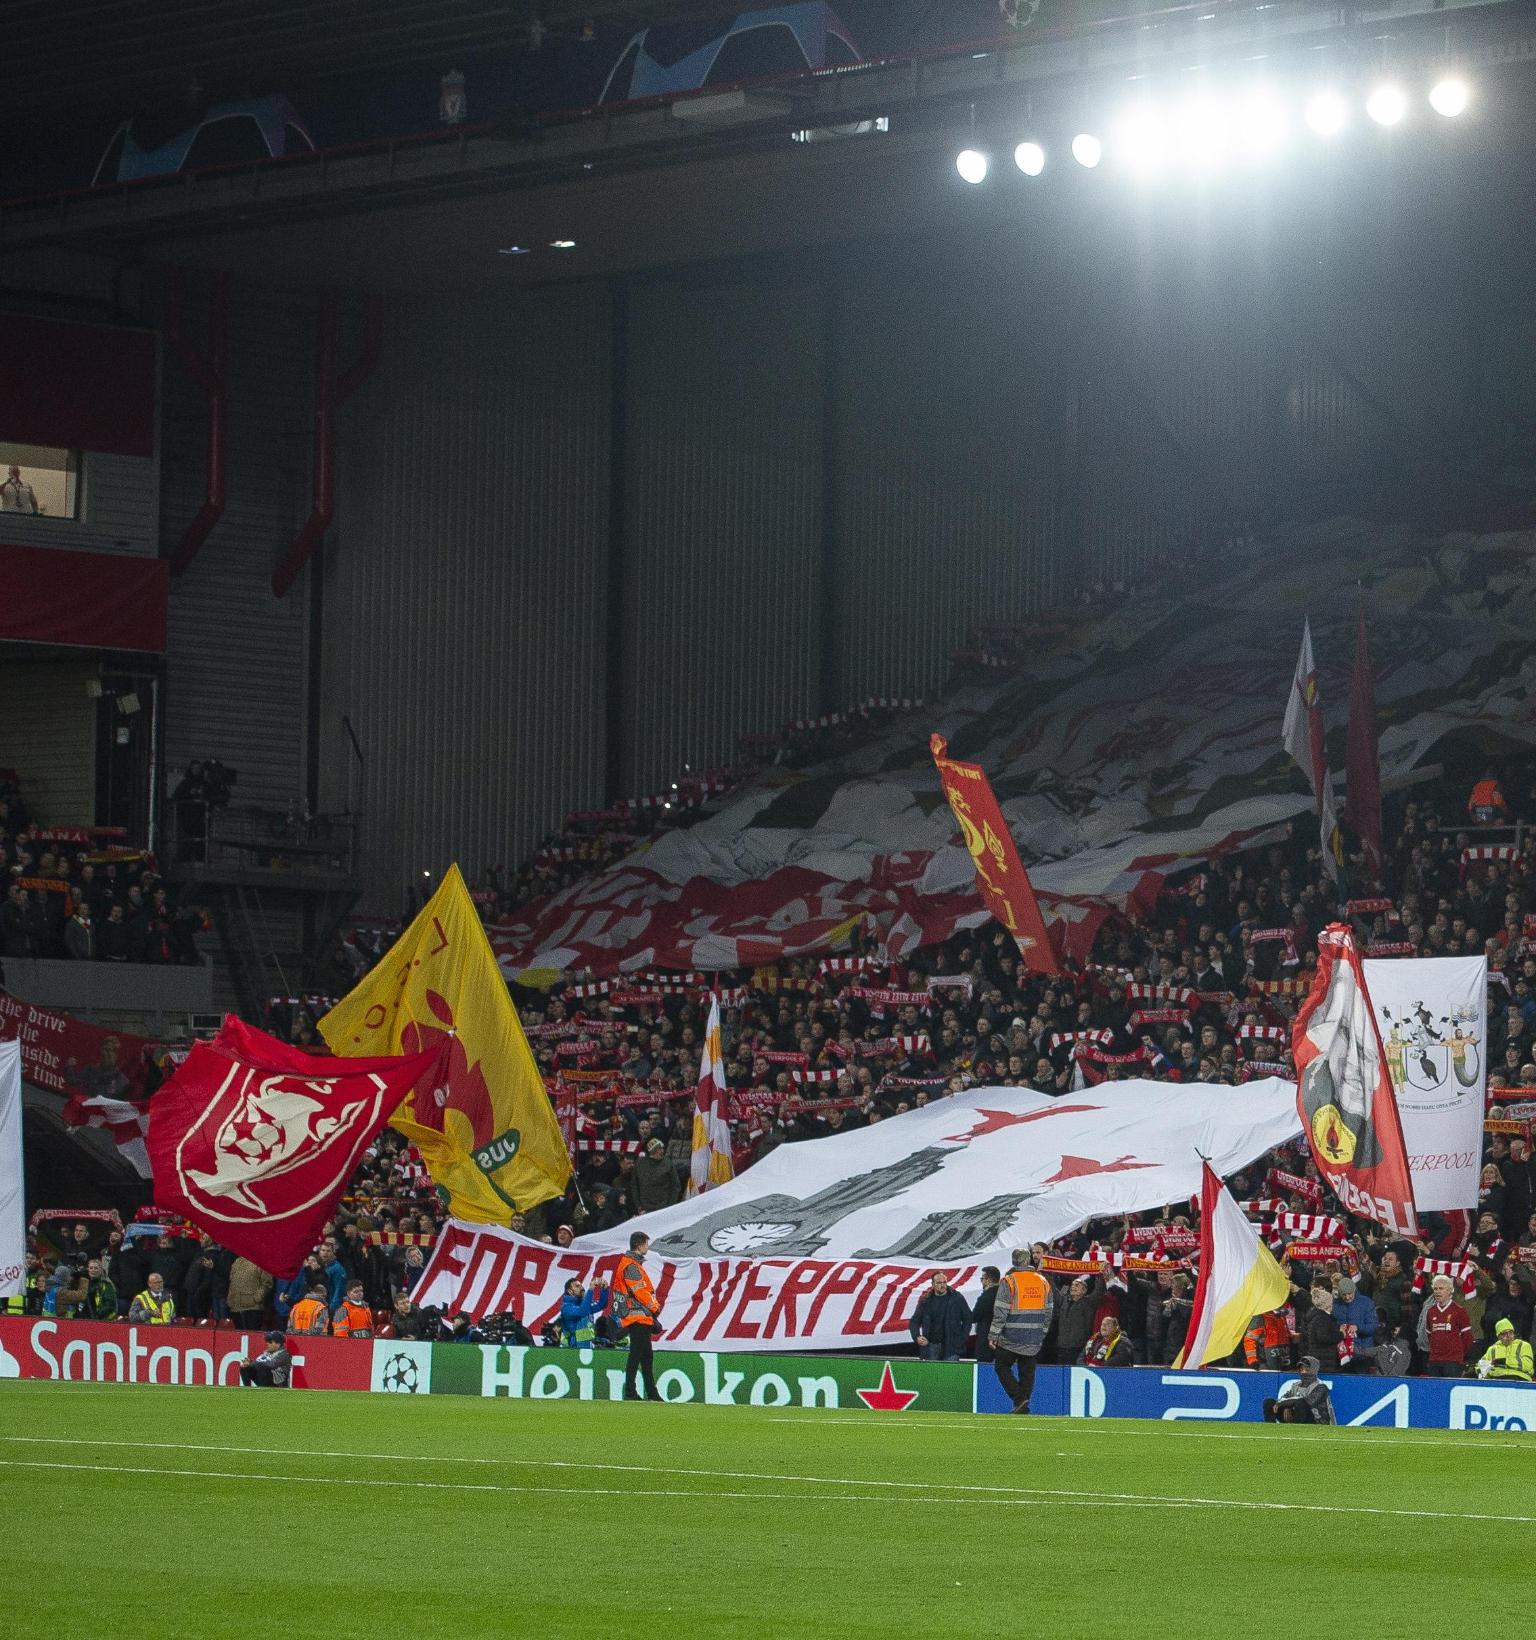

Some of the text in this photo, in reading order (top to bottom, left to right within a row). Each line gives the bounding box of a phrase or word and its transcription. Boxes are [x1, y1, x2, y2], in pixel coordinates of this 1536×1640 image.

[16, 1021, 40, 1043] the
[28, 1007, 68, 1034] drive
[33, 1065, 65, 1089] time
[1406, 1151, 1475, 1170] ERPOOL
[1294, 1246, 1309, 1255] THIS
[30, 1320, 305, 1389] Santandr
[1466, 1403, 1527, 1434] Pro
